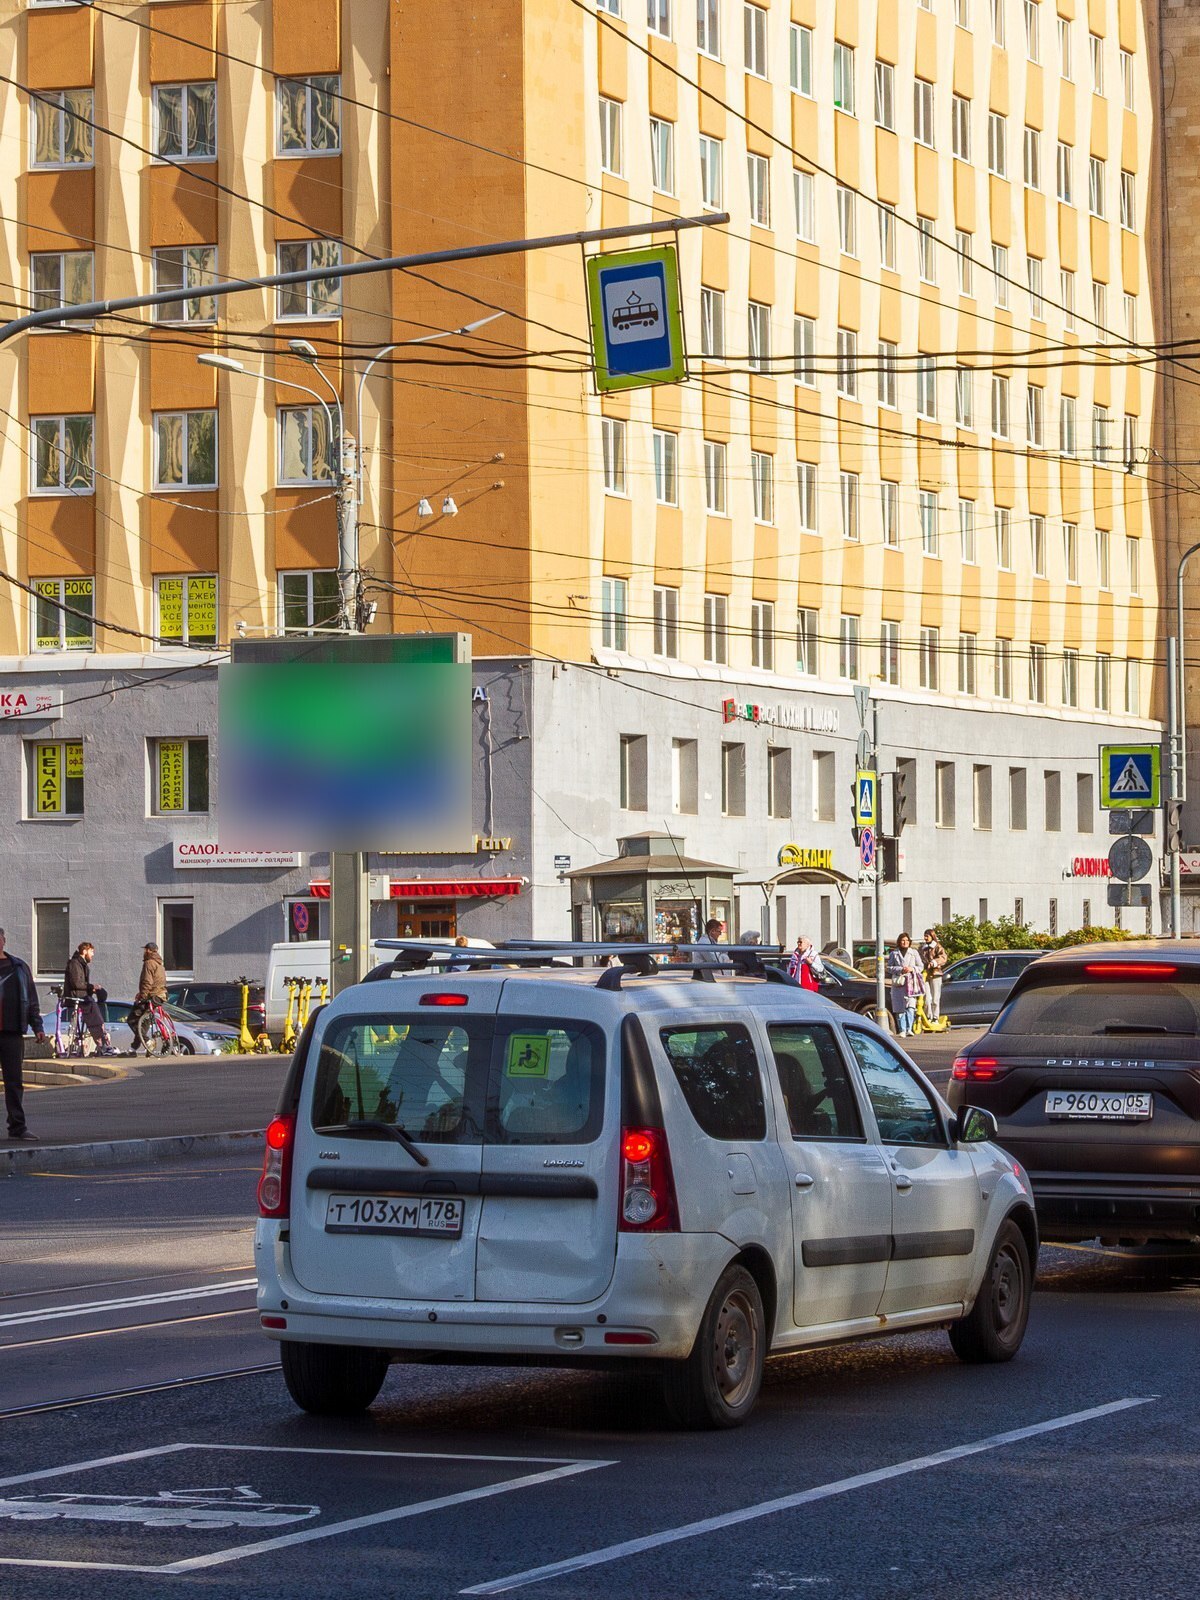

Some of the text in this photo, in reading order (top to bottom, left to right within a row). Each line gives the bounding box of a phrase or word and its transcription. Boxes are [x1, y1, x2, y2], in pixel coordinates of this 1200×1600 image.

[37, 639, 59, 648] фото
[42, 747, 56, 810] ПЕЧАТИ
[482, 837, 511, 850] CITY
[180, 858, 211, 866] маникюр
[264, 855, 294, 865] солярий
[1074, 857, 1100, 877] САЛОН
[1046, 1059, 1155, 1068] PORSCHE
[1126, 1094, 1144, 1107] 05
[319, 1151, 340, 1160] LADA
[543, 1159, 584, 1168] LARGUS
[422, 1200, 455, 1220] 178
[428, 1220, 446, 1228] RUS
